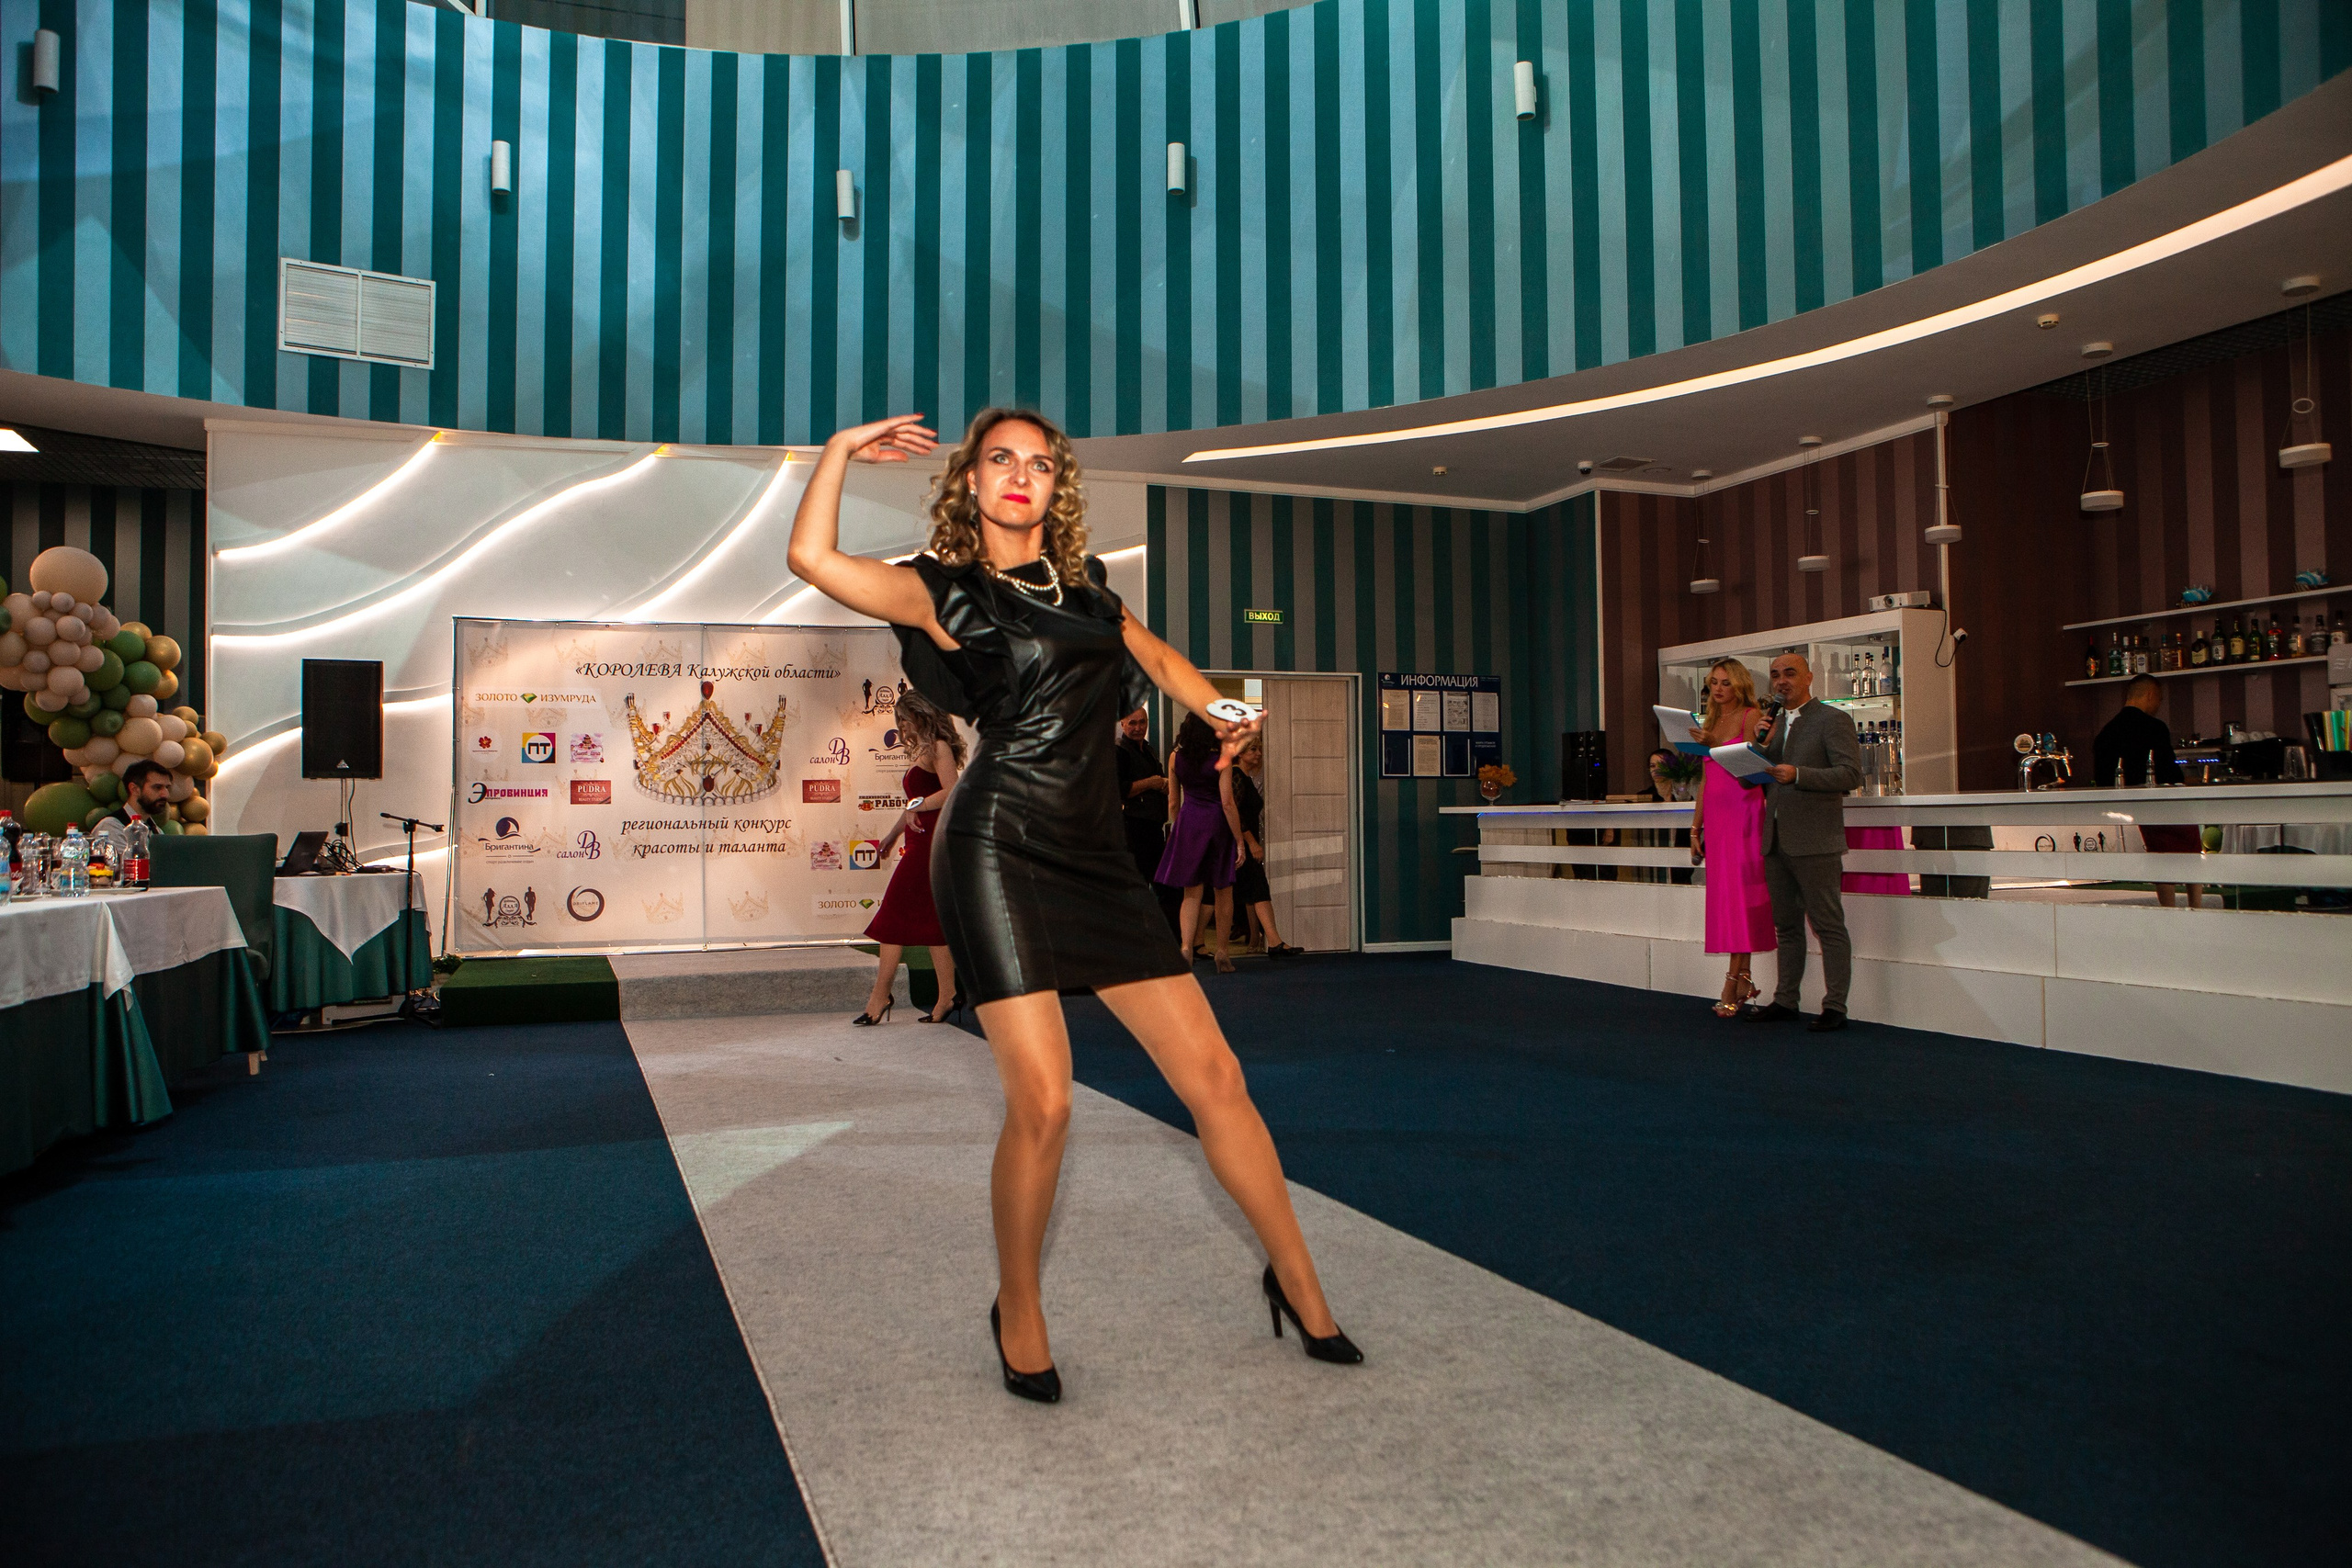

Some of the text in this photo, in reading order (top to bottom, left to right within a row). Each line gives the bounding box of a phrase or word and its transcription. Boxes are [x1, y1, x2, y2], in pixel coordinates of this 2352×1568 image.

[1249, 611, 1280, 622] ВЫХОД
[575, 662, 841, 682] «КОРОЛЕВА Калужской области»
[1400, 674, 1478, 689] ИНФОРМАЦИЯ
[475, 693, 596, 704] ЗОЛОТО ИЗУМРУДА
[1221, 704, 1248, 716] 3
[527, 742, 550, 755] ПТ
[809, 756, 835, 764] салон
[875, 752, 910, 761] Бриганти
[875, 799, 909, 807] РАБОЧ
[621, 817, 792, 835] региональный конкурс
[485, 842, 534, 852] Бригантина
[633, 842, 786, 859] красоты и таланта
[556, 851, 584, 859] салон
[854, 849, 876, 862] ПТ
[818, 899, 857, 909] ЗОЛОТО
